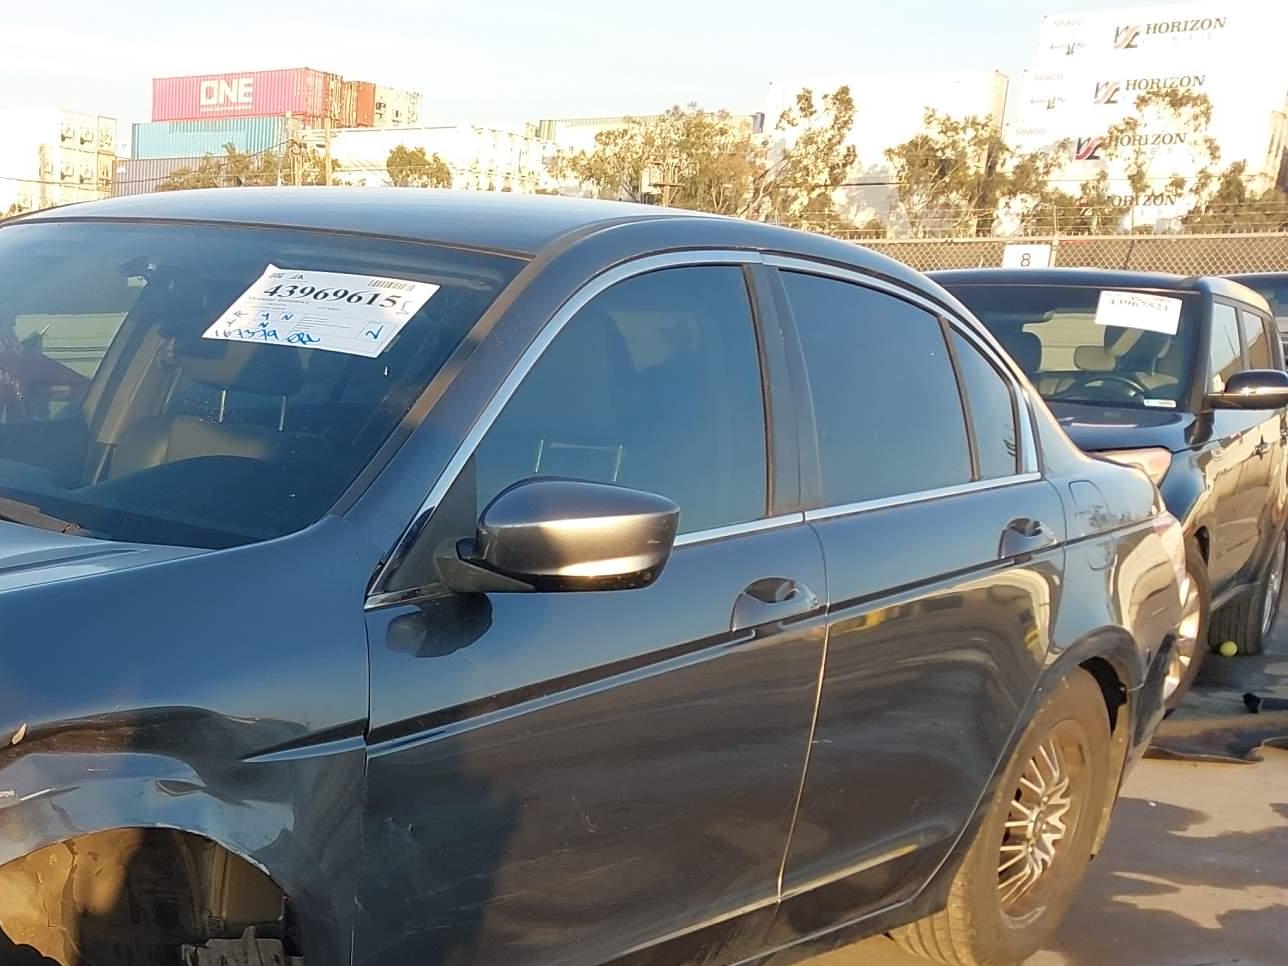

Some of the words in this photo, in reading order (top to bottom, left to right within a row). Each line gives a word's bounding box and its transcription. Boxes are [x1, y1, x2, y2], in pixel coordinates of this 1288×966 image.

[1145, 17, 1227, 35] HORIZON
[200, 78, 253, 106] ONE
[1126, 75, 1206, 91] HORIZON
[1020, 253, 1031, 267] 8
[263, 283, 403, 309] 43969615
